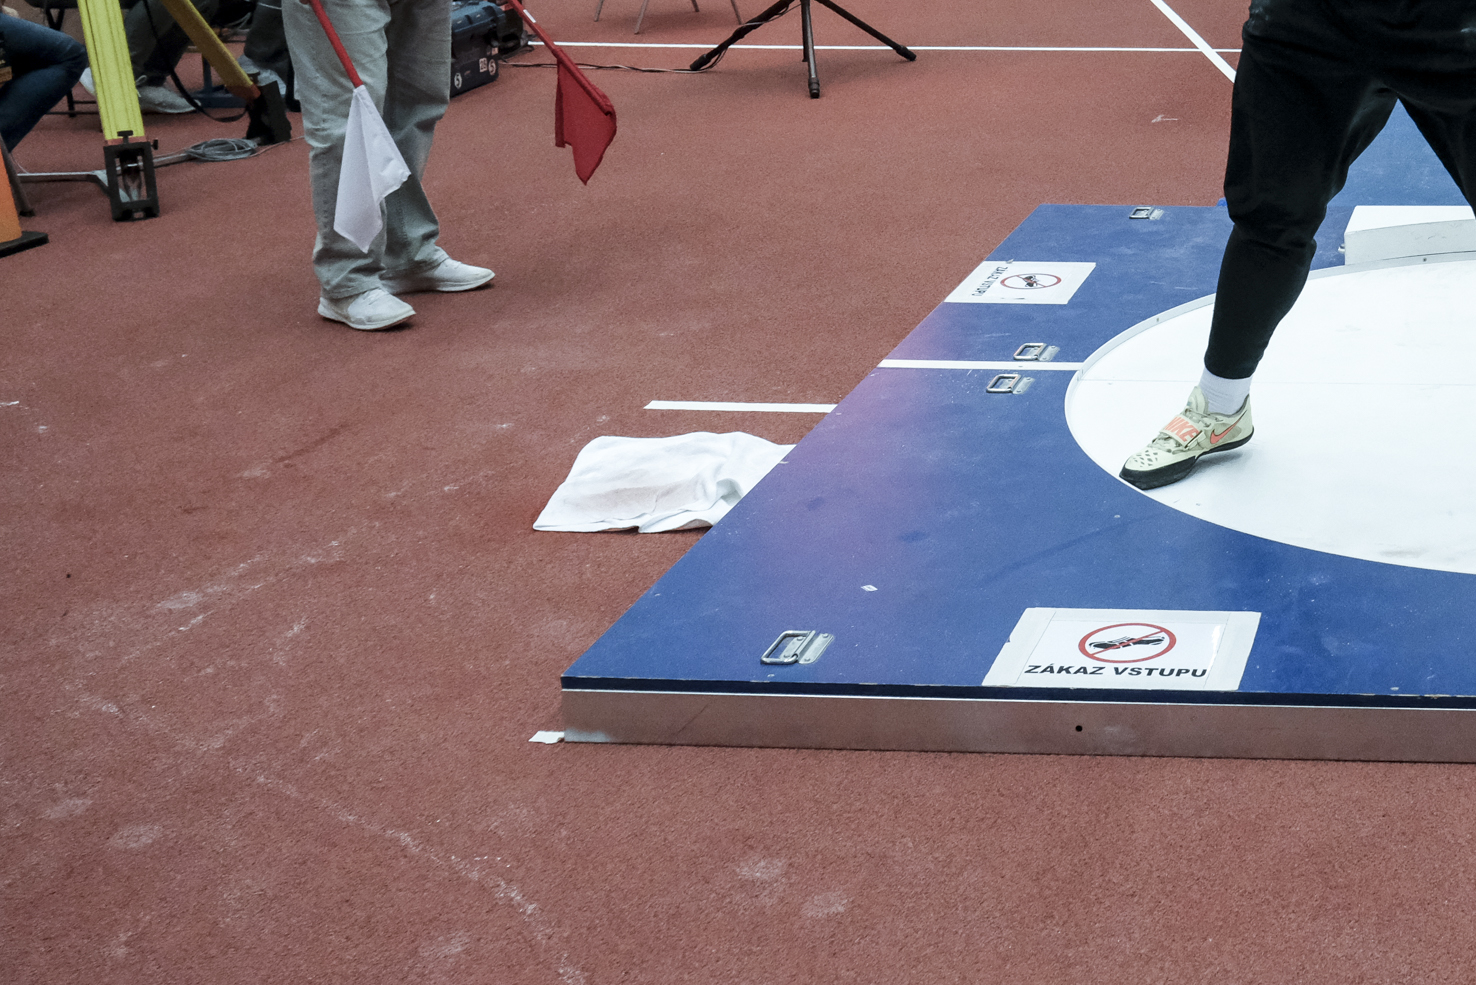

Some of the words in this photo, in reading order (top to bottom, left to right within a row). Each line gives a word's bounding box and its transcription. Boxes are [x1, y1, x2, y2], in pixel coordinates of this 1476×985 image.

[1164, 416, 1200, 442] NIKE
[1024, 663, 1105, 675] ZÁKAZ
[1113, 666, 1208, 678] VSTUPU
